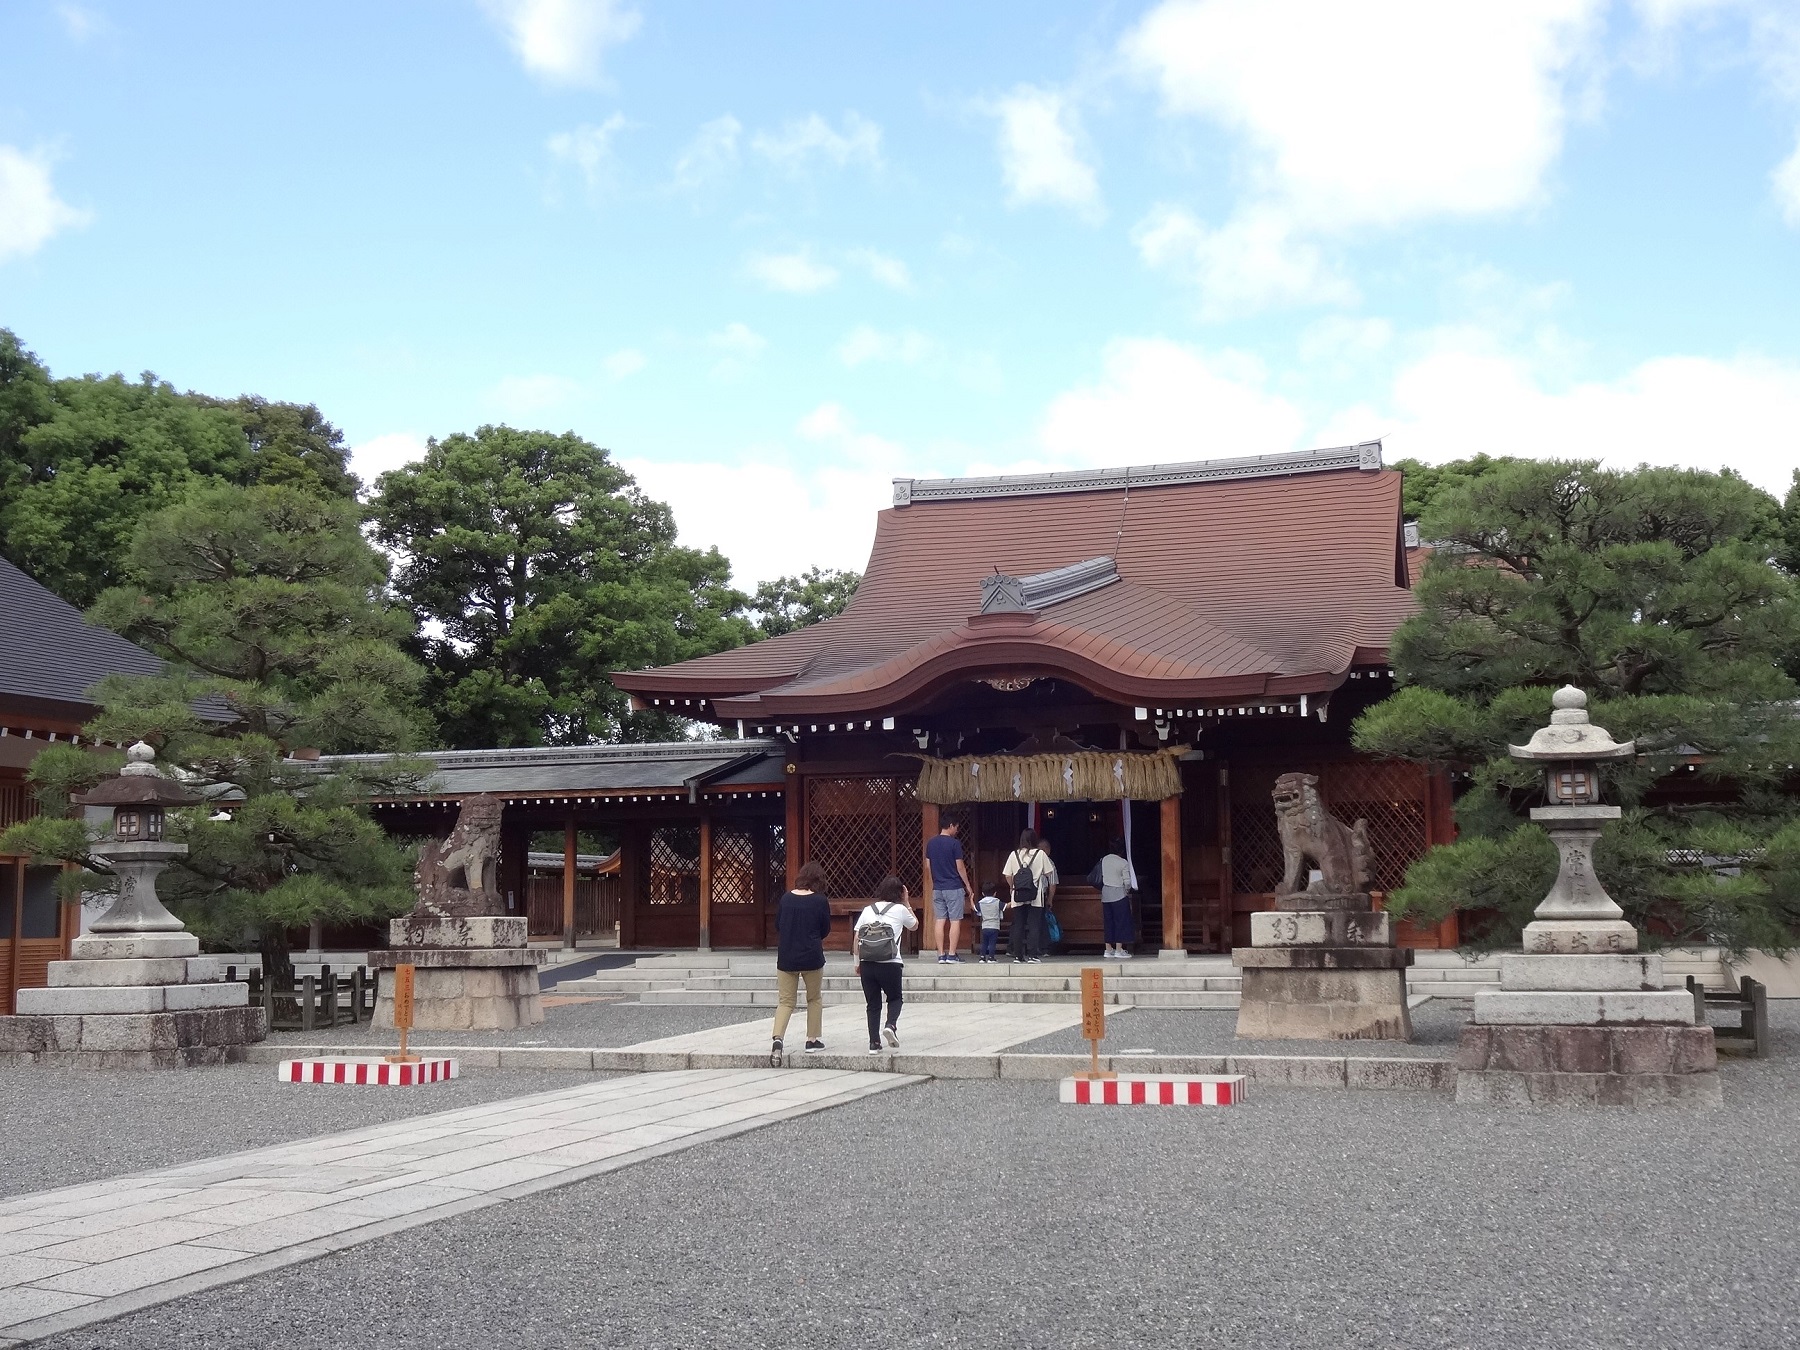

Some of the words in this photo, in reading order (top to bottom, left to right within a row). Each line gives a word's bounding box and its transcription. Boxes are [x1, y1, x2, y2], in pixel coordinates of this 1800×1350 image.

[1092, 972, 1100, 1034] 七五三おめでとう
